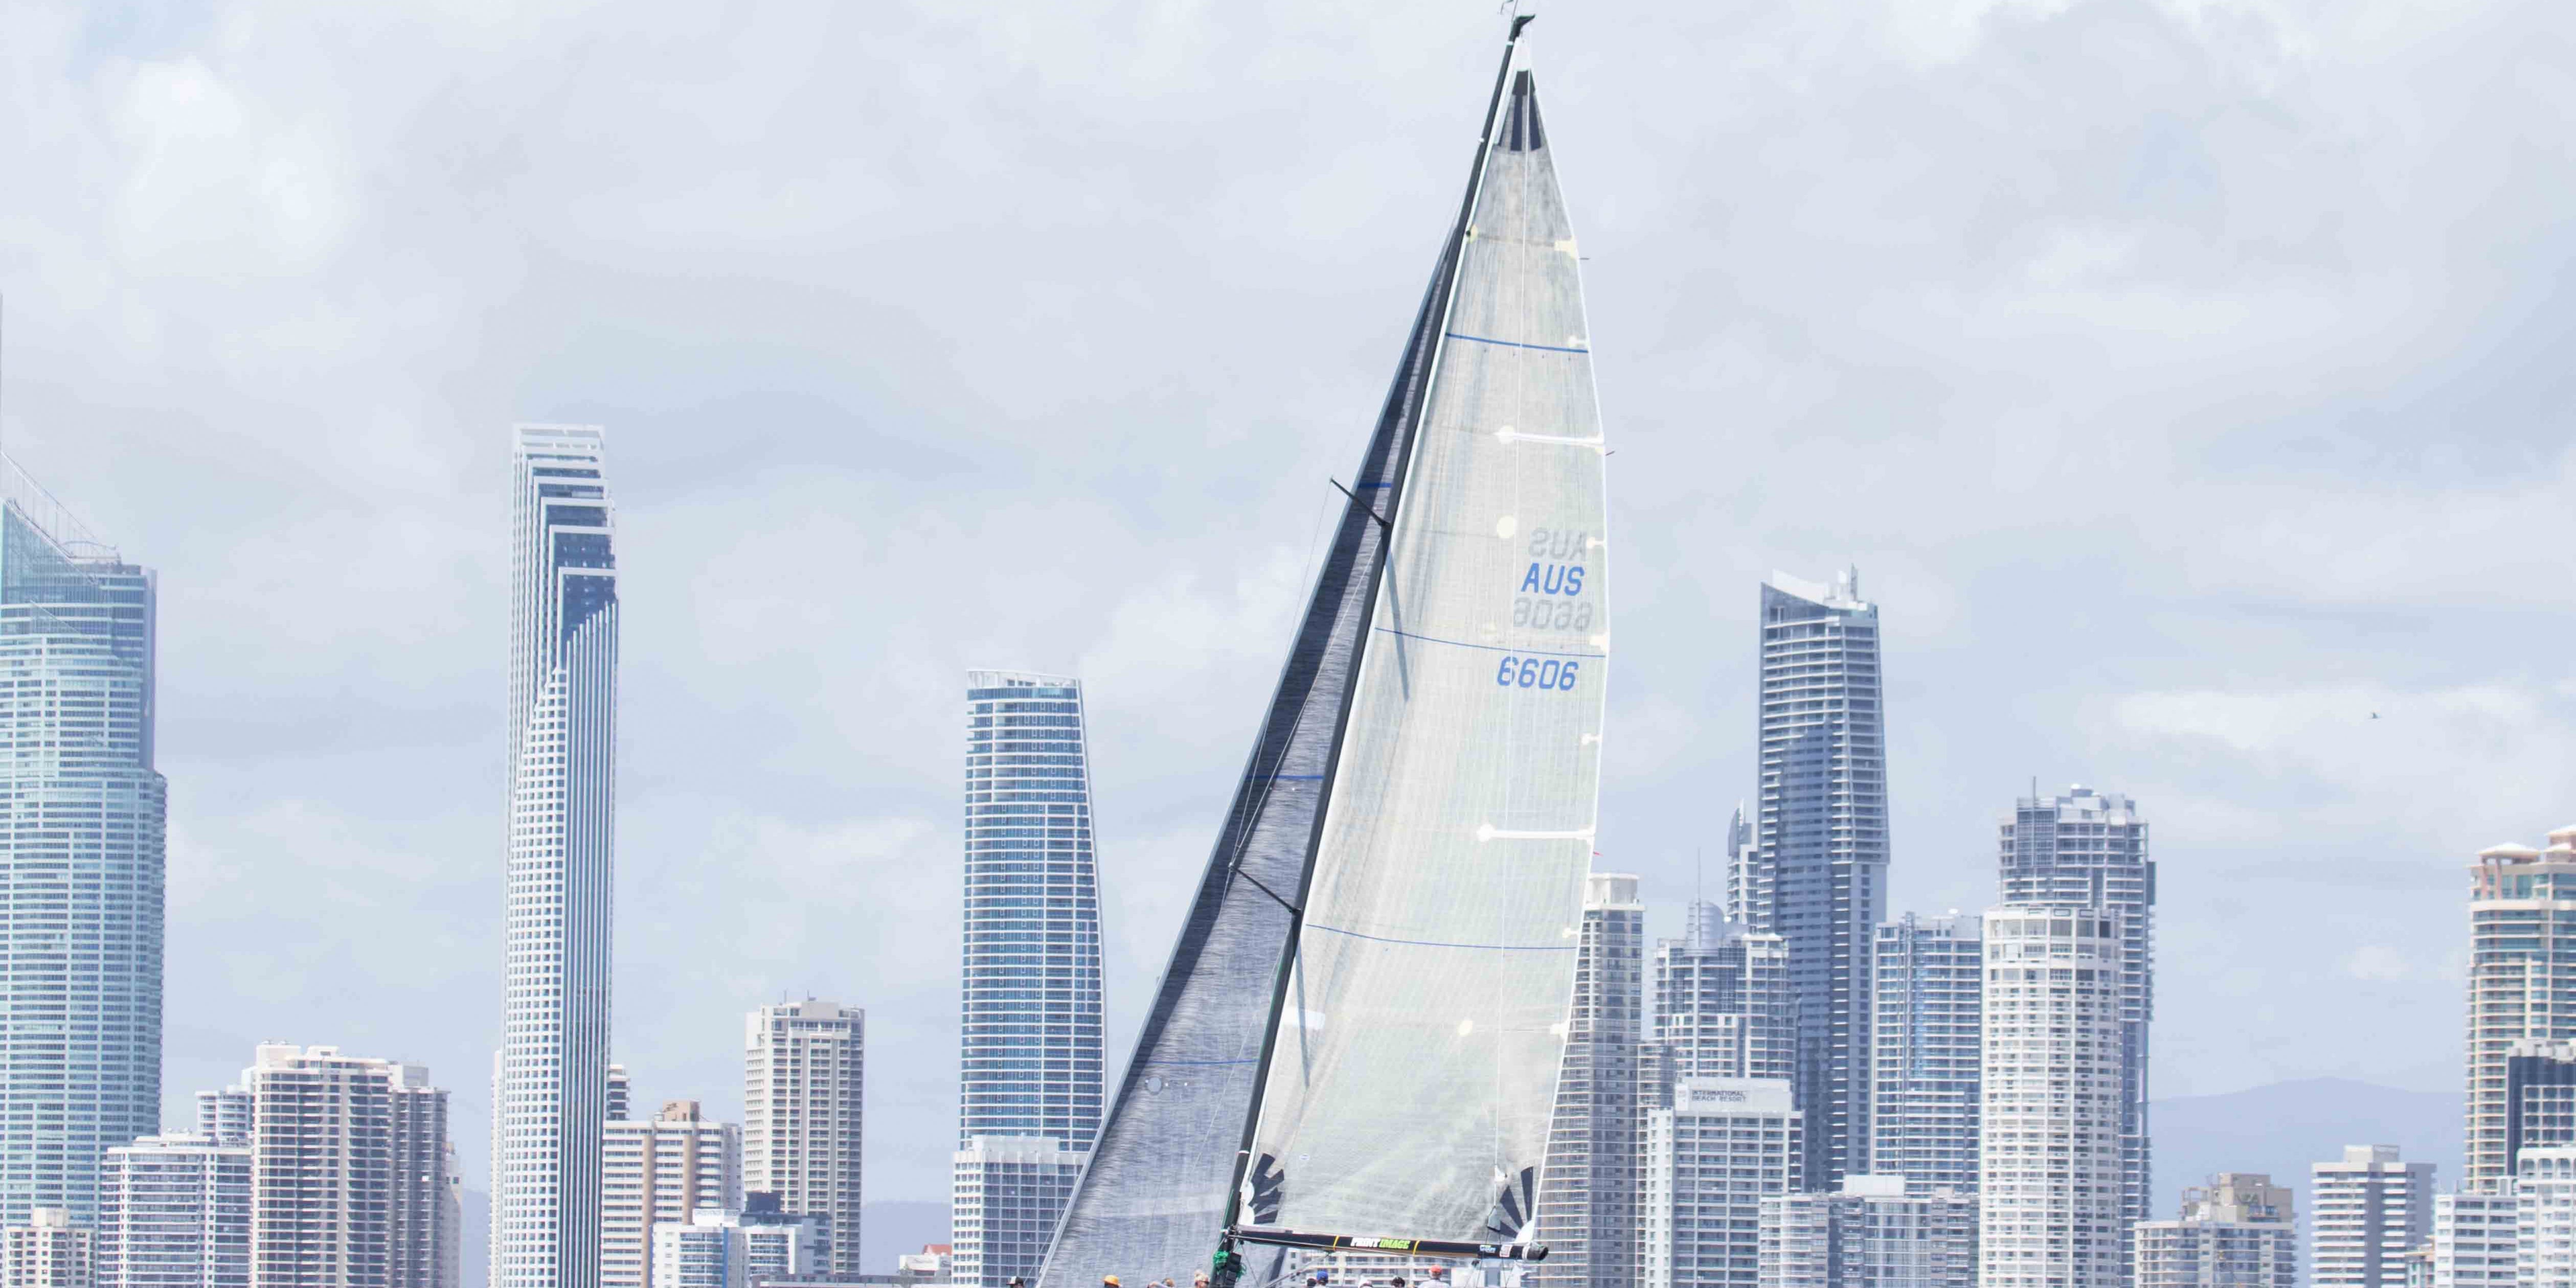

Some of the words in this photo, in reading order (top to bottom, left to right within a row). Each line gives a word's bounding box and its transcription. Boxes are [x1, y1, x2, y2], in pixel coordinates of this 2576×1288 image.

[1521, 562, 1585, 596] AUS
[1497, 656, 1579, 691] 6606
[1379, 1239, 1411, 1250] IMAGE
